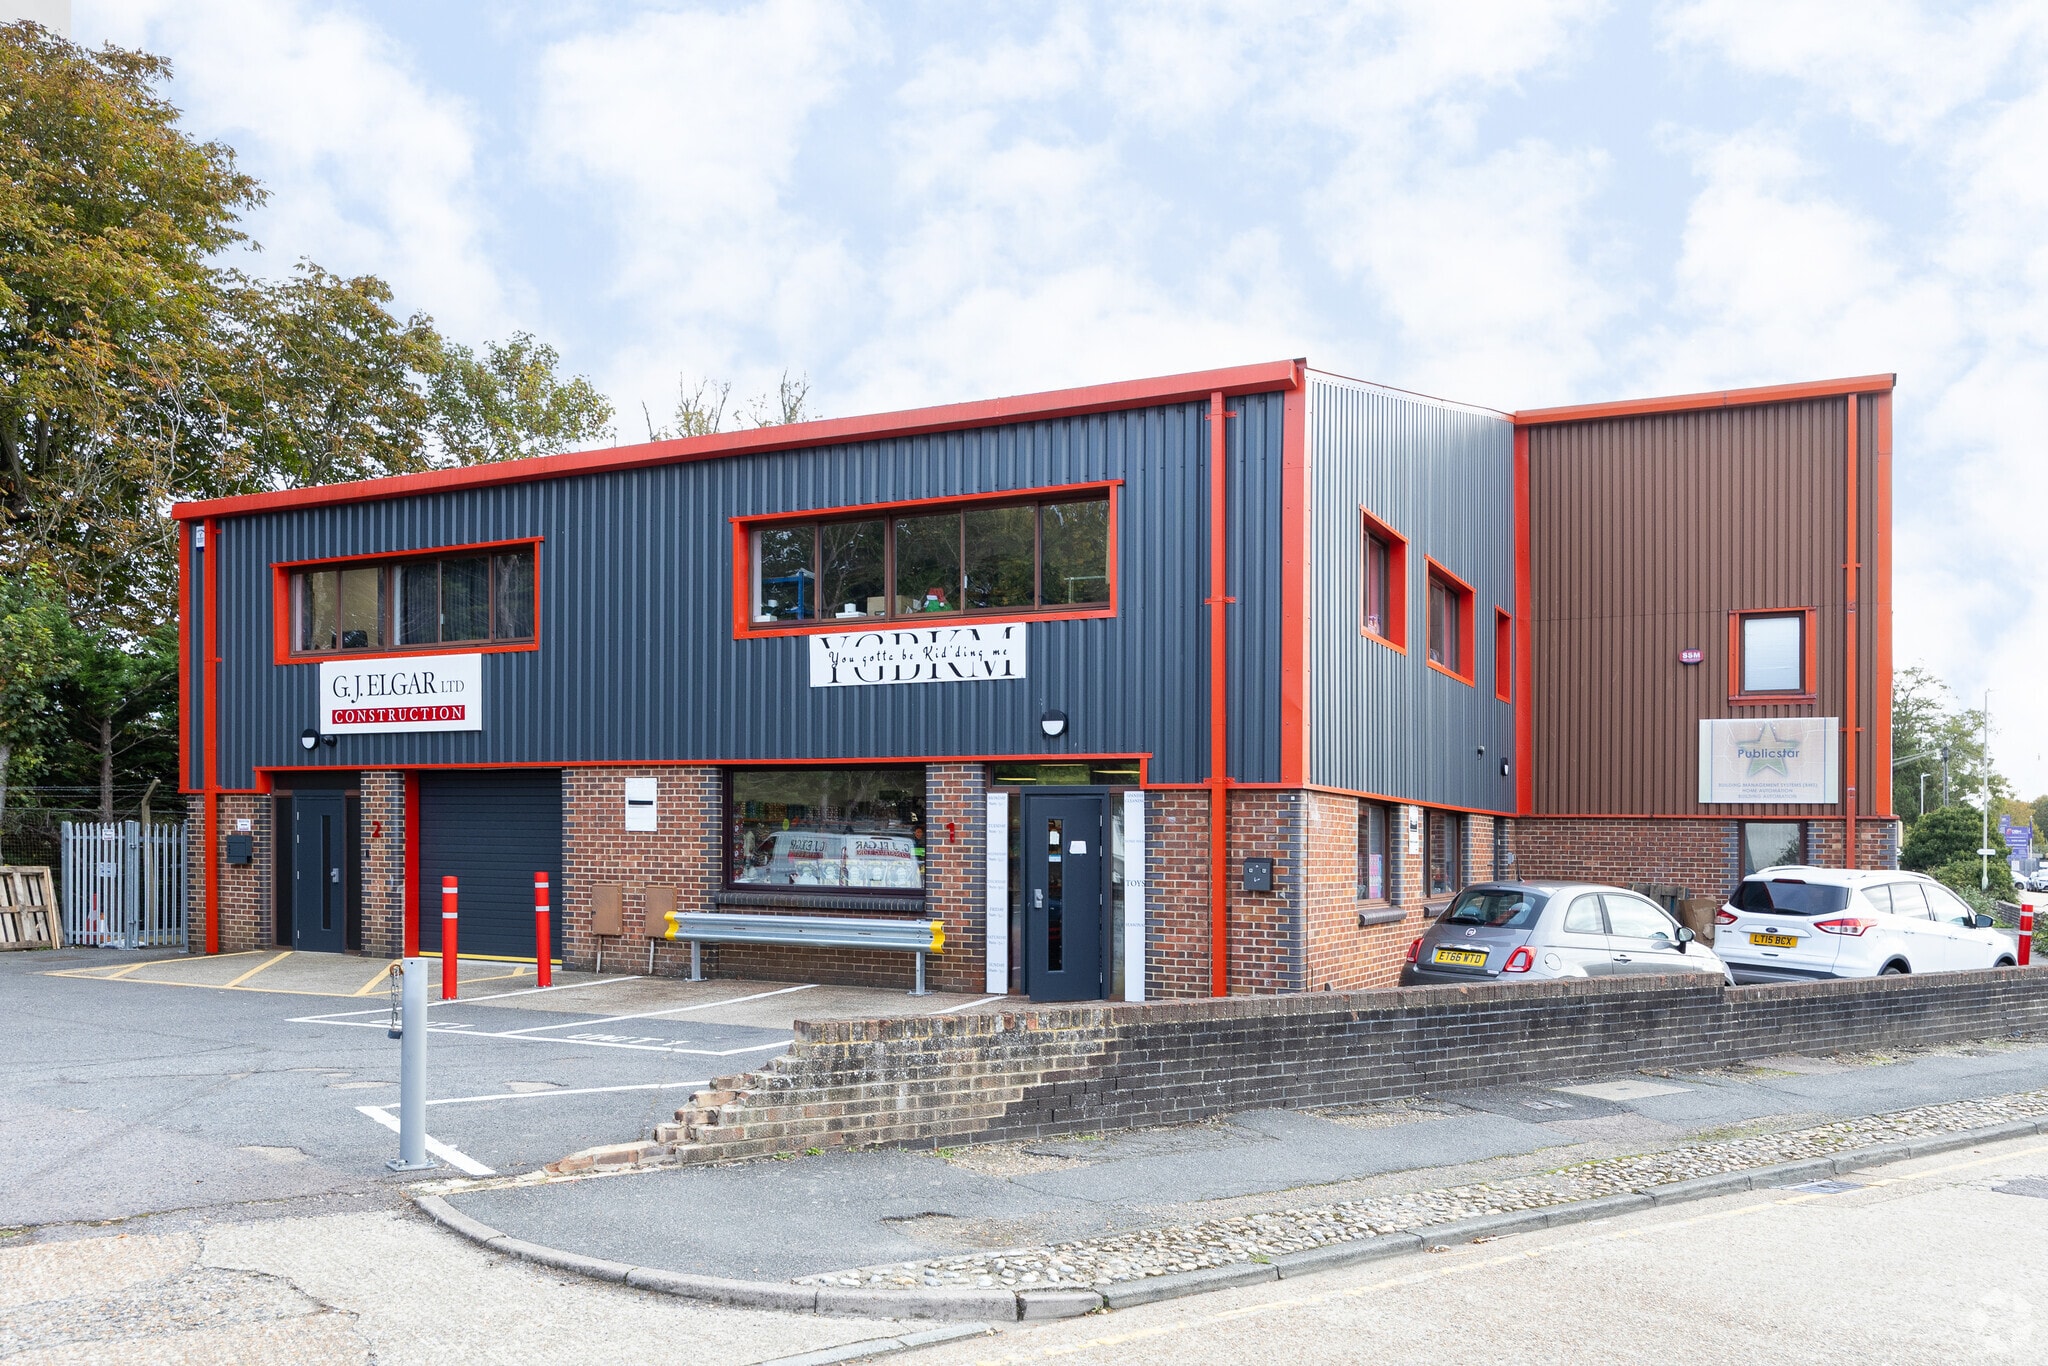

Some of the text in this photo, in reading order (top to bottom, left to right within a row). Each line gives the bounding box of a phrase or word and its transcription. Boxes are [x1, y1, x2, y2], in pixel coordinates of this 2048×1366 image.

[828, 650, 854, 669] You
[902, 648, 914, 660] be
[992, 648, 1007, 656] me
[441, 679, 465, 693] LTD
[334, 706, 464, 724] CONSTRUCTION
[1737, 748, 1800, 759] Publicstar
[372, 820, 381, 838] 2
[946, 822, 955, 843] 1
[1126, 879, 1146, 887] TOYS
[1754, 934, 1793, 946] LT15 BCX
[1439, 951, 1482, 964] ET66 WTD
